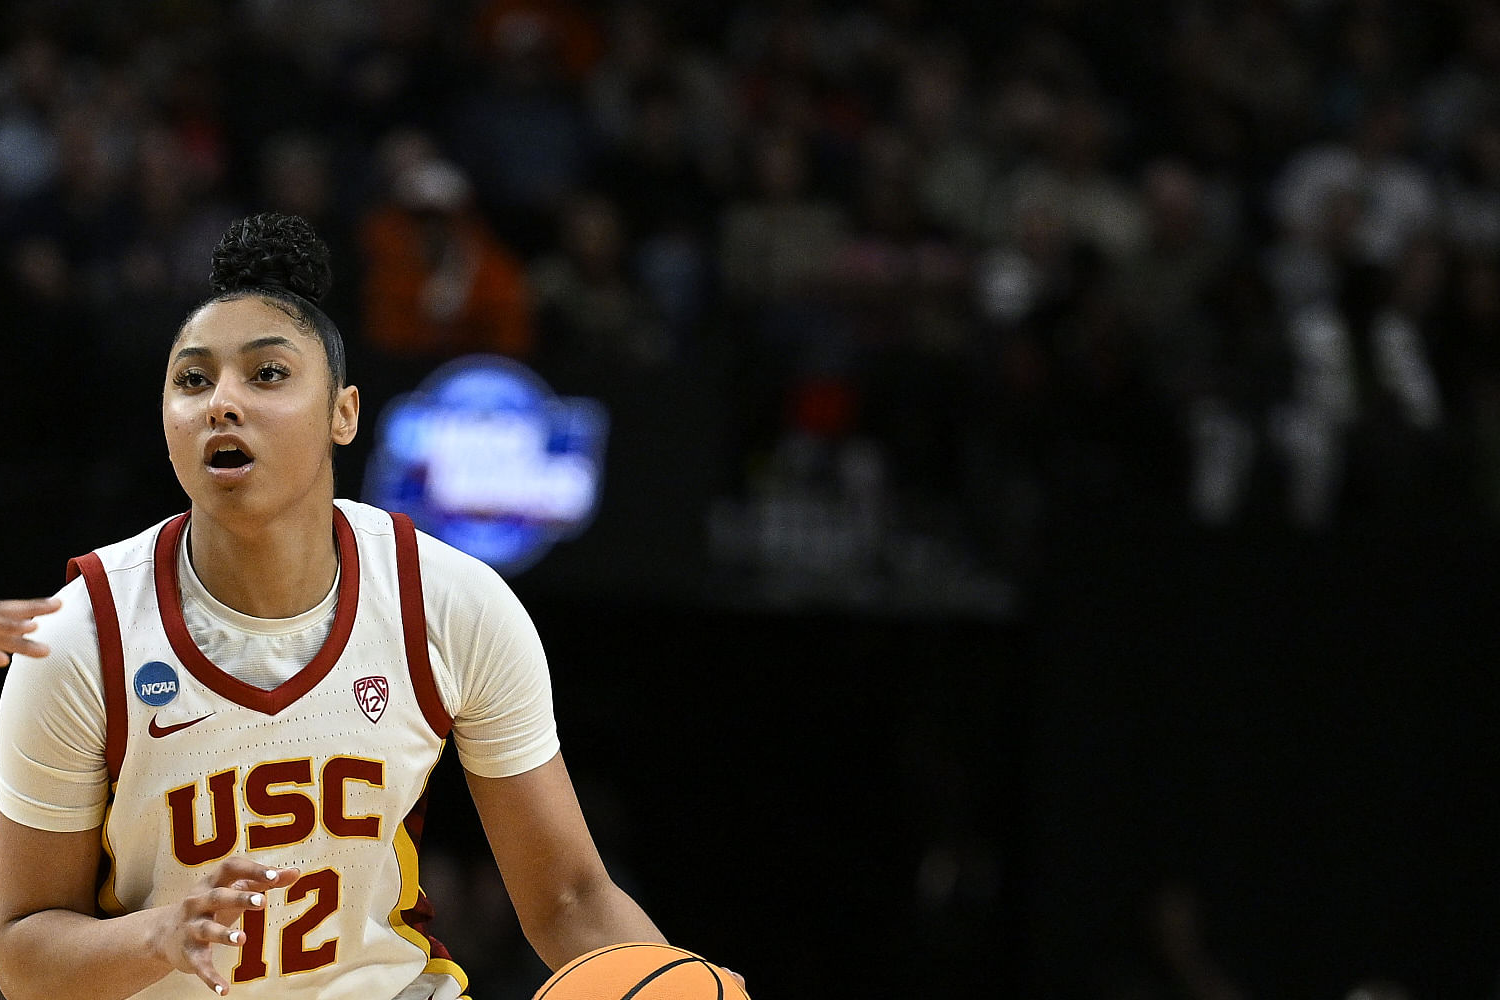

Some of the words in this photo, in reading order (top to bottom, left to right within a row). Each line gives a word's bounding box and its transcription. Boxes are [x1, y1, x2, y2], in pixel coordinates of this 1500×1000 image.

[141, 681, 177, 696] NCAA
[356, 678, 386, 705] PAC
[364, 695, 381, 712] 12
[166, 755, 386, 867] USC
[231, 866, 341, 984] 12
